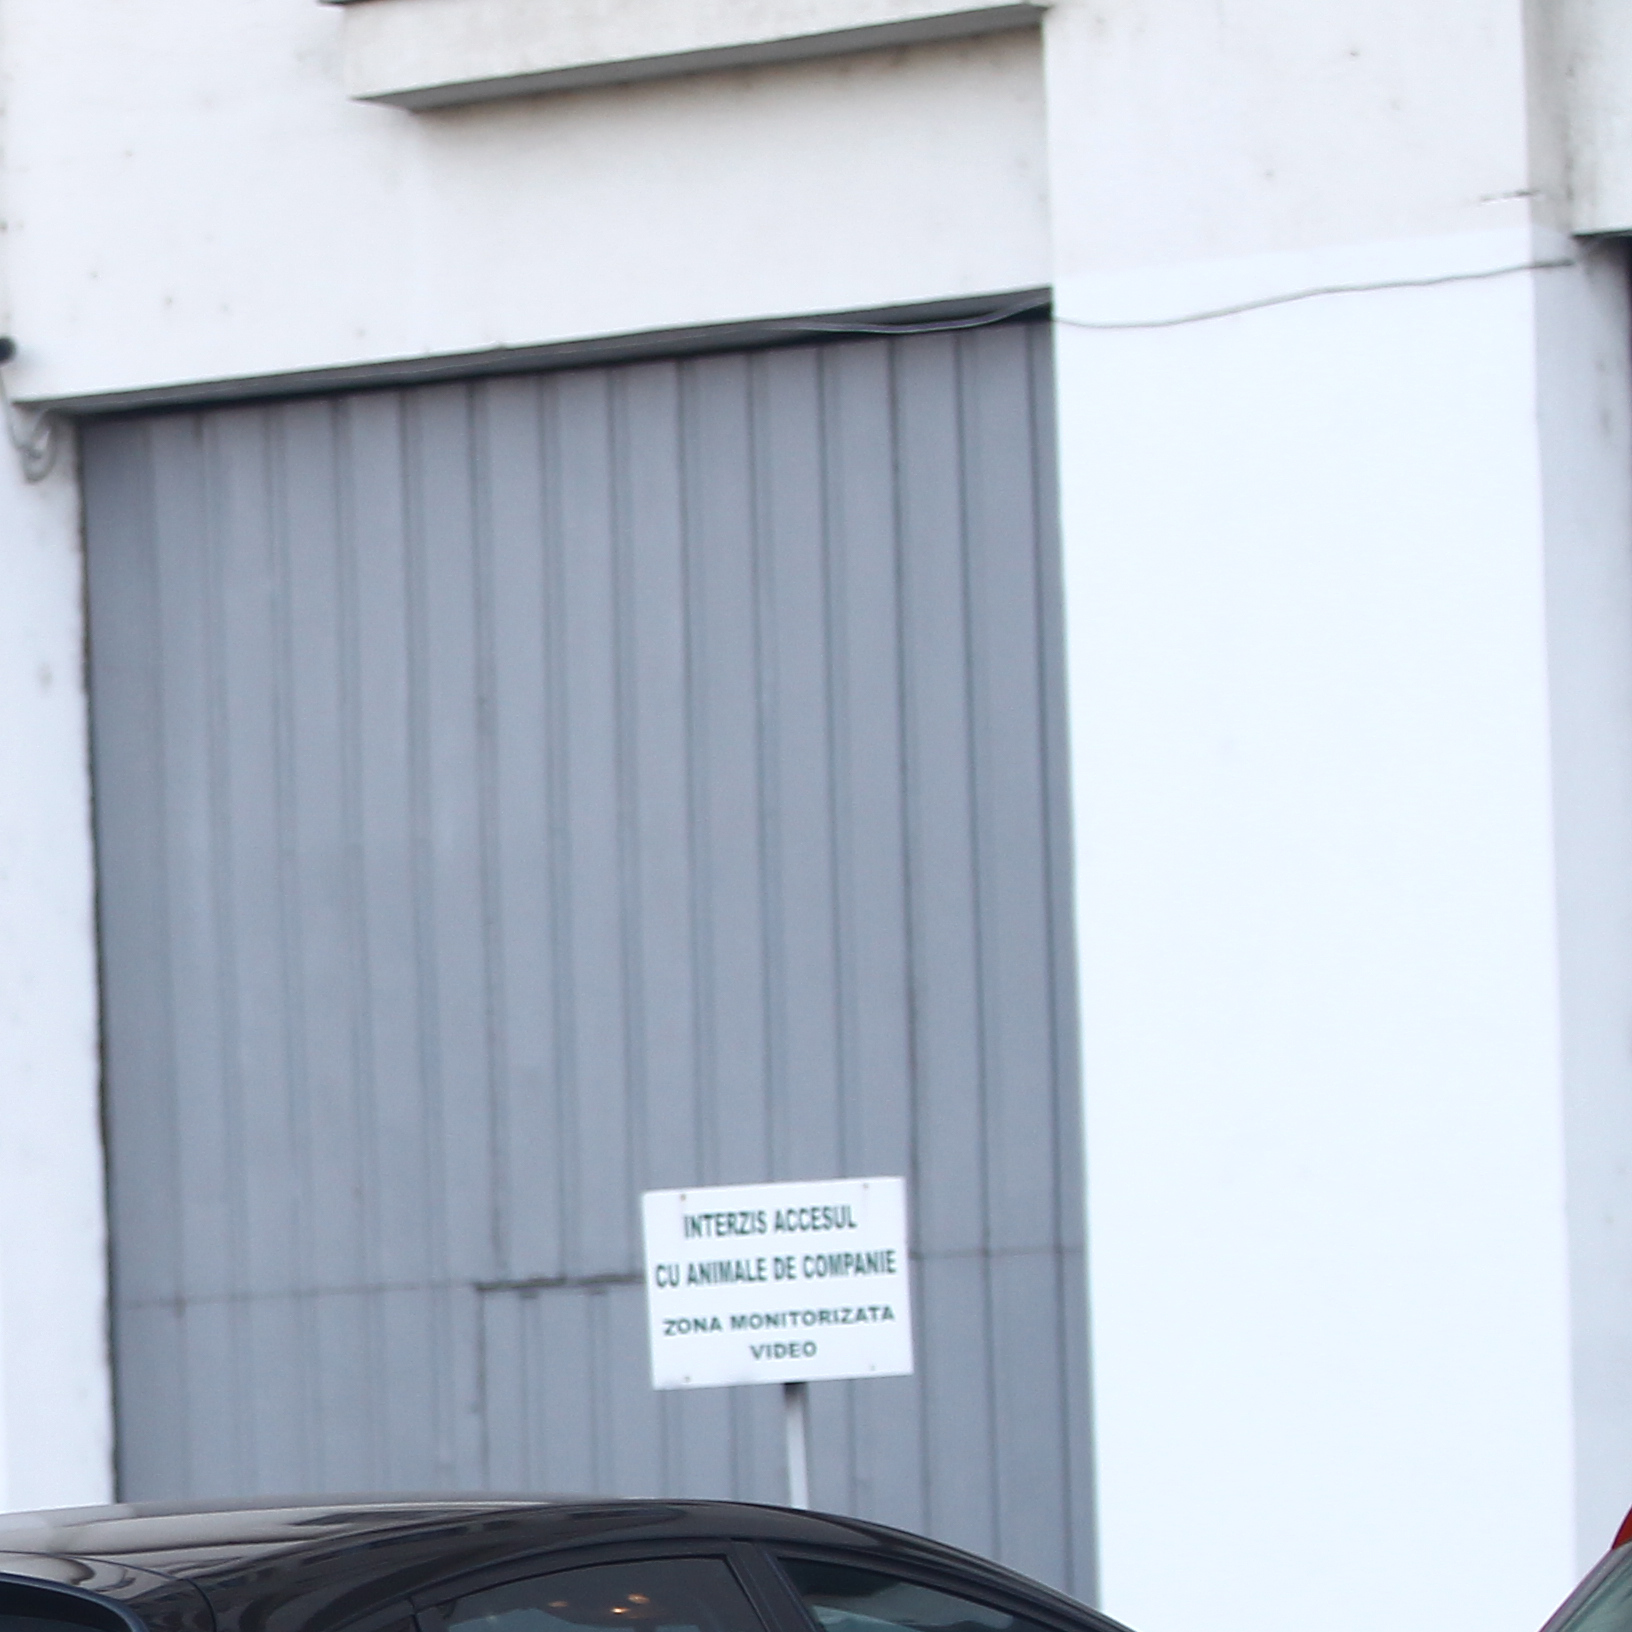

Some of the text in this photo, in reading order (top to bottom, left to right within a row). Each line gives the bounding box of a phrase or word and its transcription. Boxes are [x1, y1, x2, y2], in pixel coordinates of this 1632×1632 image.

[684, 1205, 858, 1238] INTERZIS ACCESUL
[656, 1249, 897, 1288] CU ANIMALE DE COMPANIE
[663, 1304, 895, 1337] ZONA MONITORIZATA
[749, 1340, 818, 1361] VIDEO
